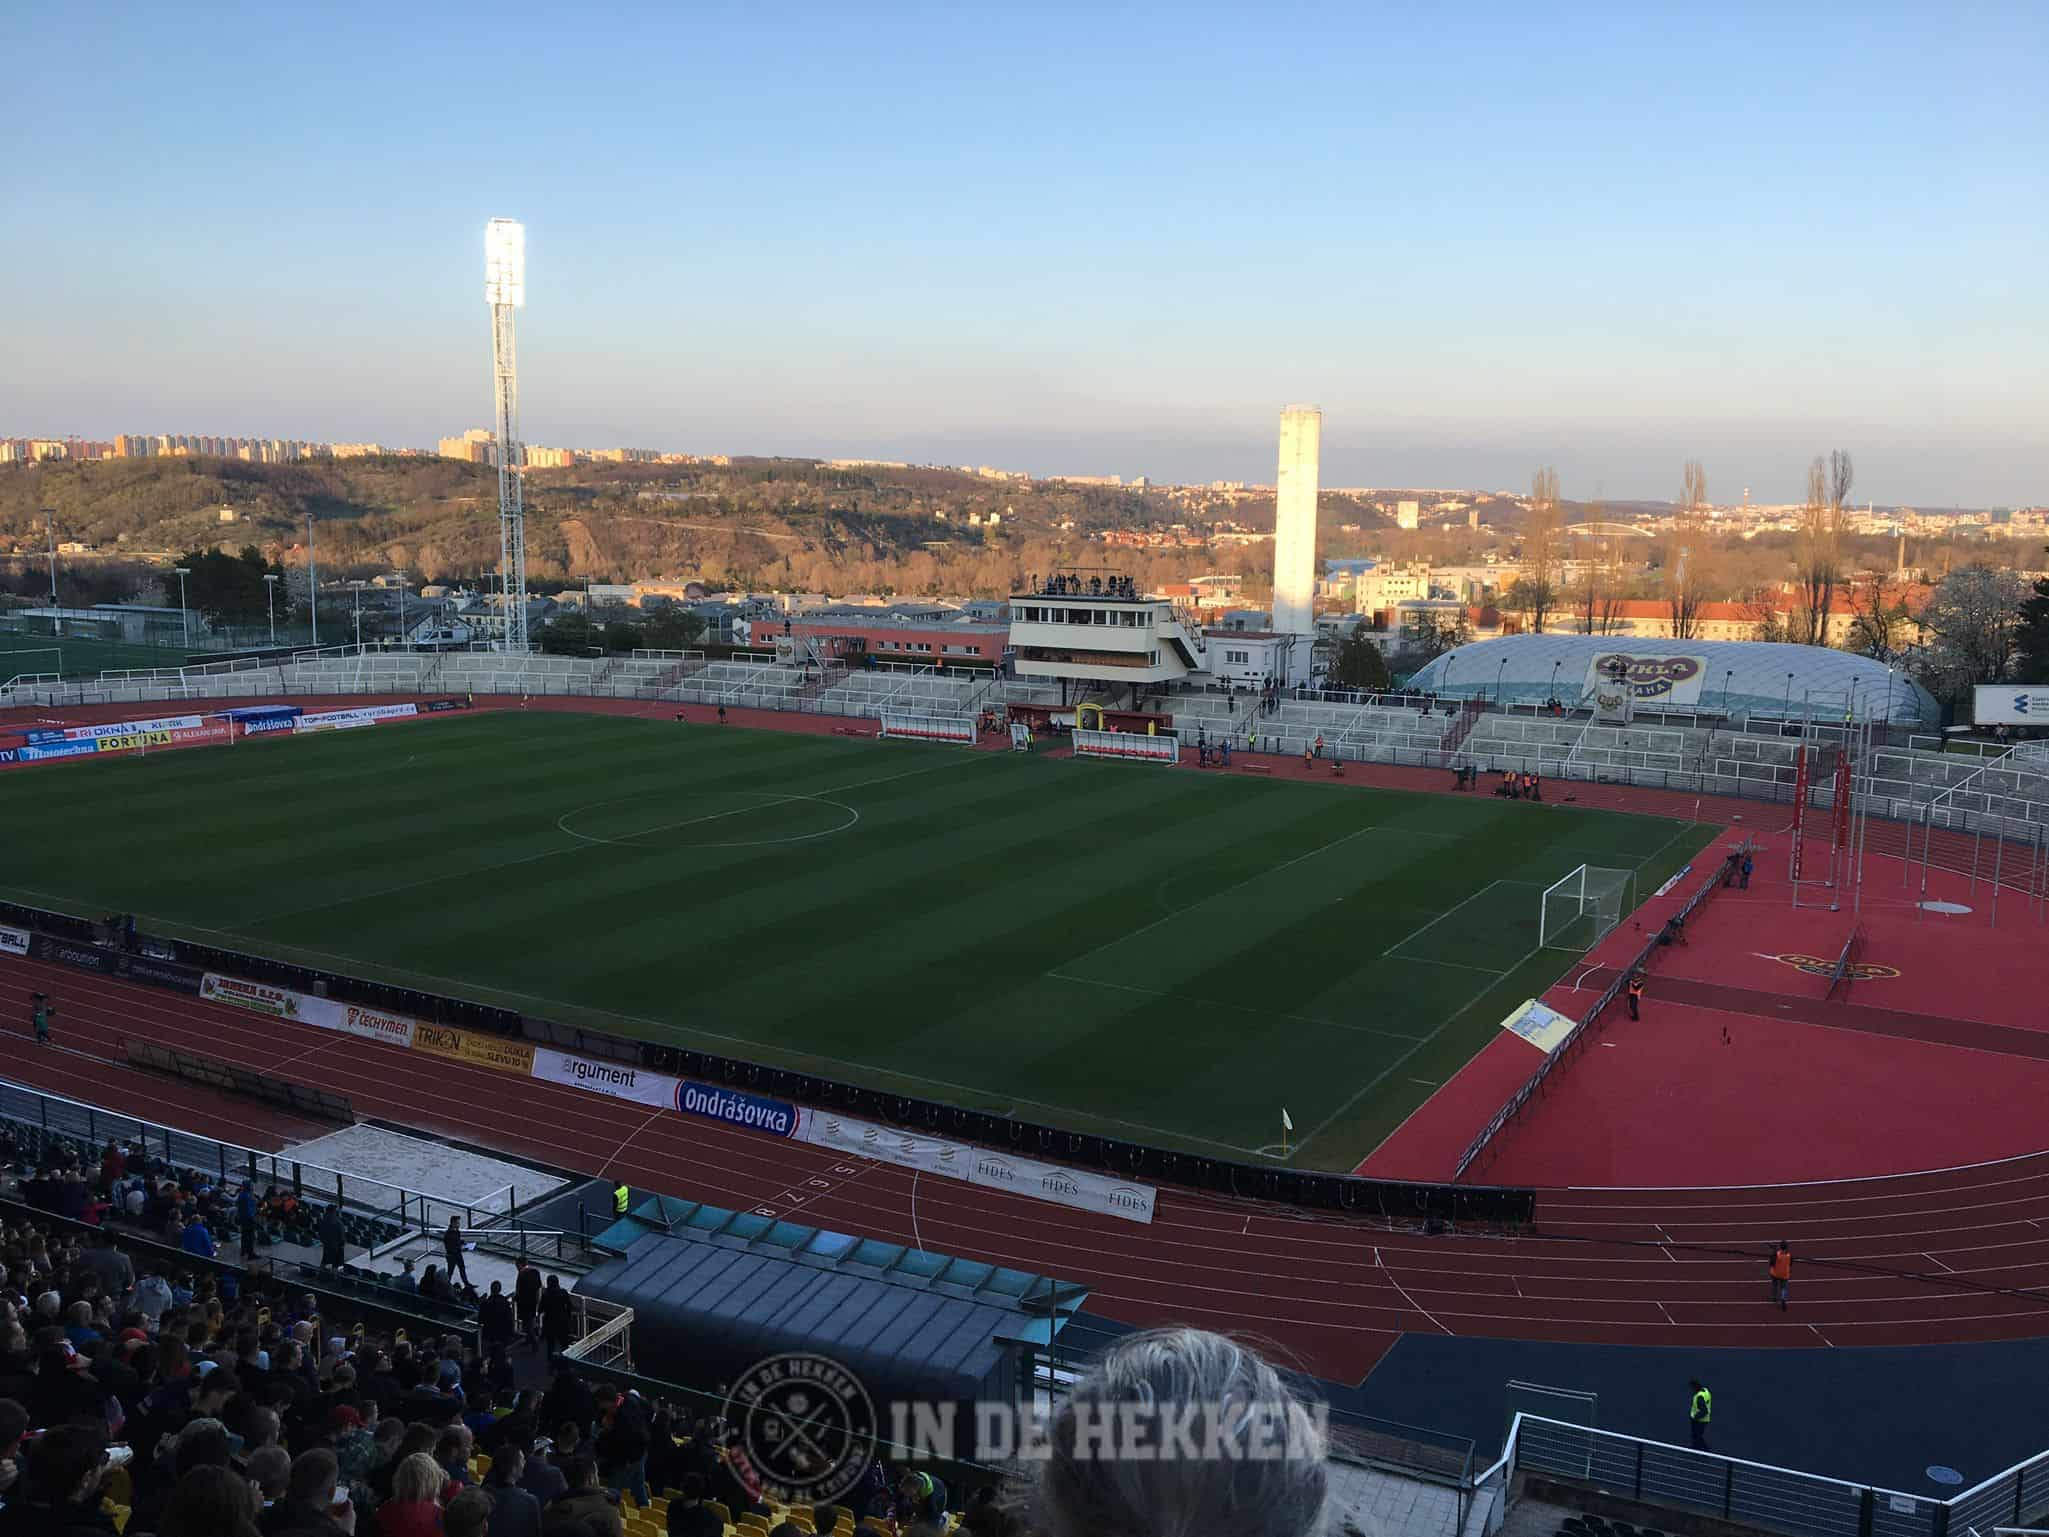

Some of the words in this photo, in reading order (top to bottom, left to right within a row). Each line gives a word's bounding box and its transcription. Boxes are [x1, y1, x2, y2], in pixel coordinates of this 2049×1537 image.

[100, 732, 170, 750] FORTUNA
[562, 1056, 637, 1088] argument
[979, 1162, 1016, 1181] FIDES
[1042, 1176, 1079, 1196] FIDES
[1108, 1191, 1148, 1212] FIDES
